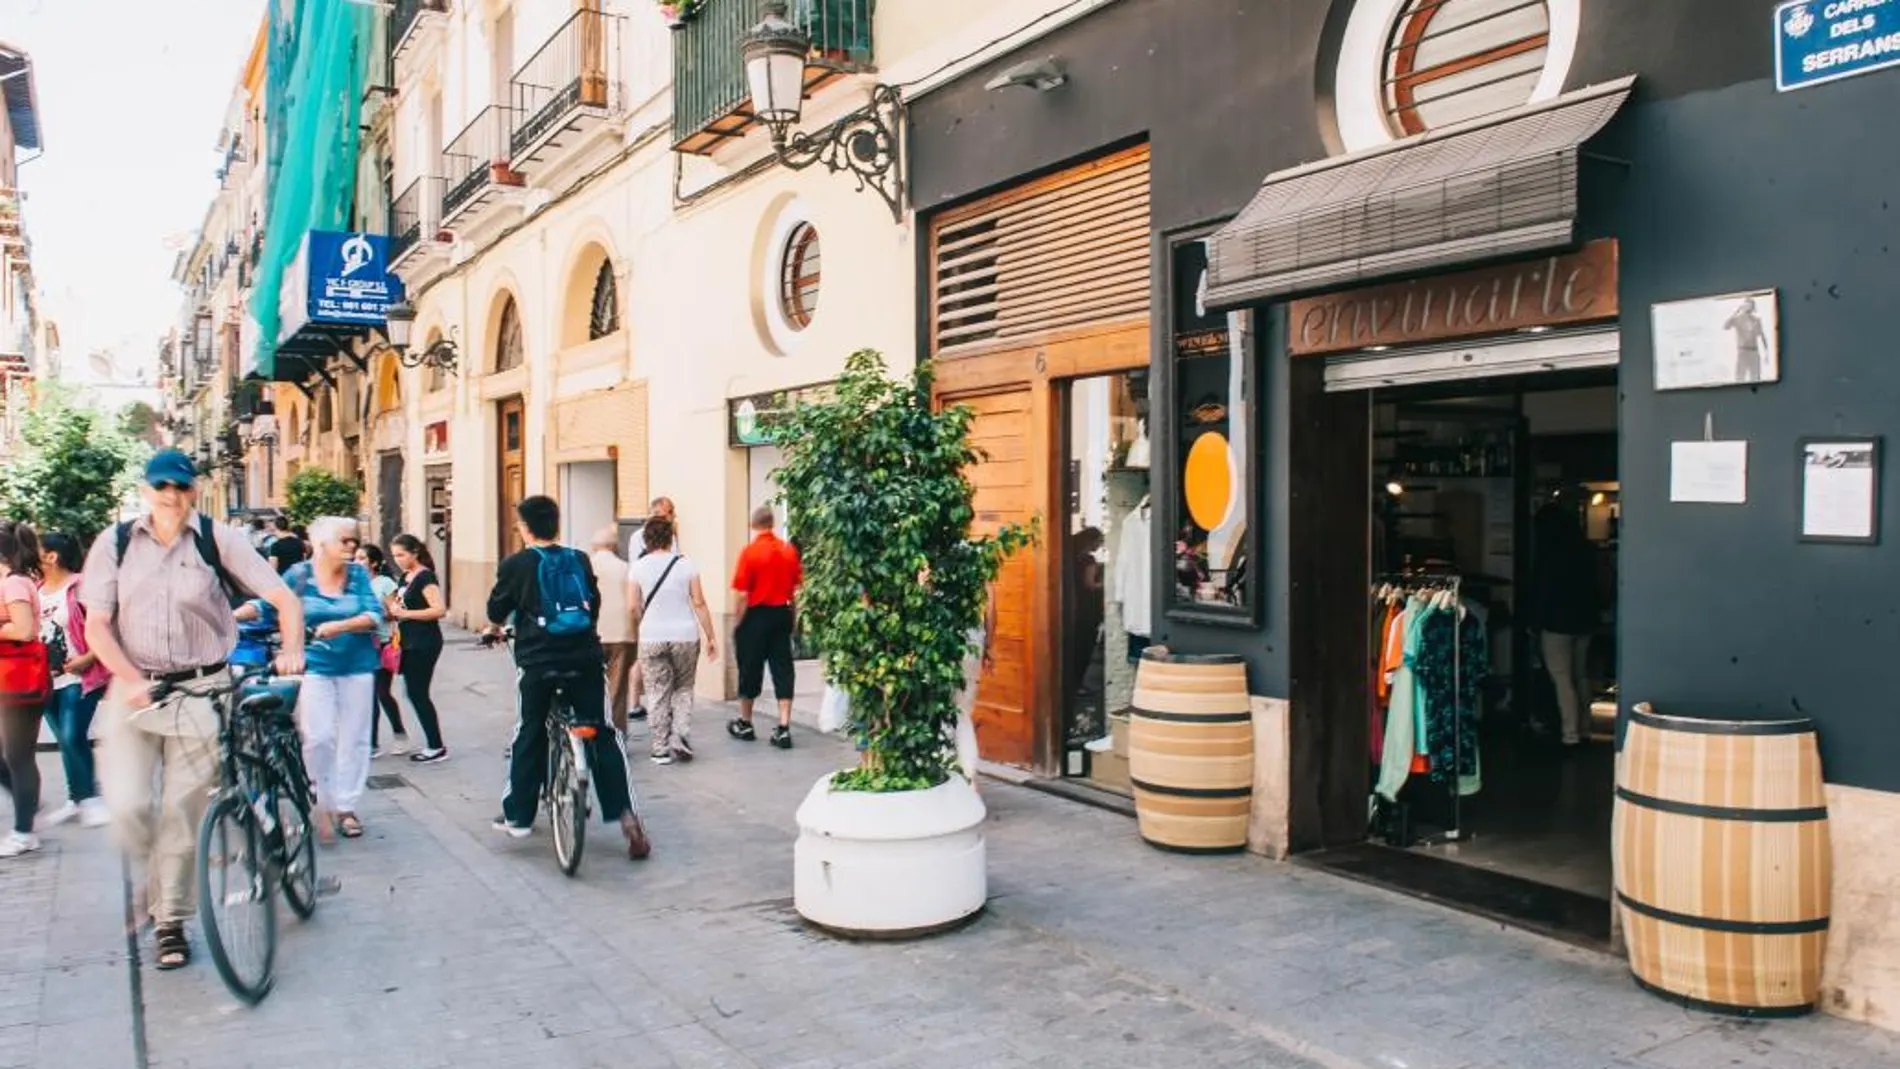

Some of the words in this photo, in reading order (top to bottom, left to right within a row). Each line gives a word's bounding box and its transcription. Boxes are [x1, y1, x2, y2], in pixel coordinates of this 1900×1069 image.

[1824, 0, 1893, 19] CARRE
[1830, 13, 1875, 38] DELS
[1301, 257, 1594, 346] envinarte
[1036, 351, 1046, 373] 6
